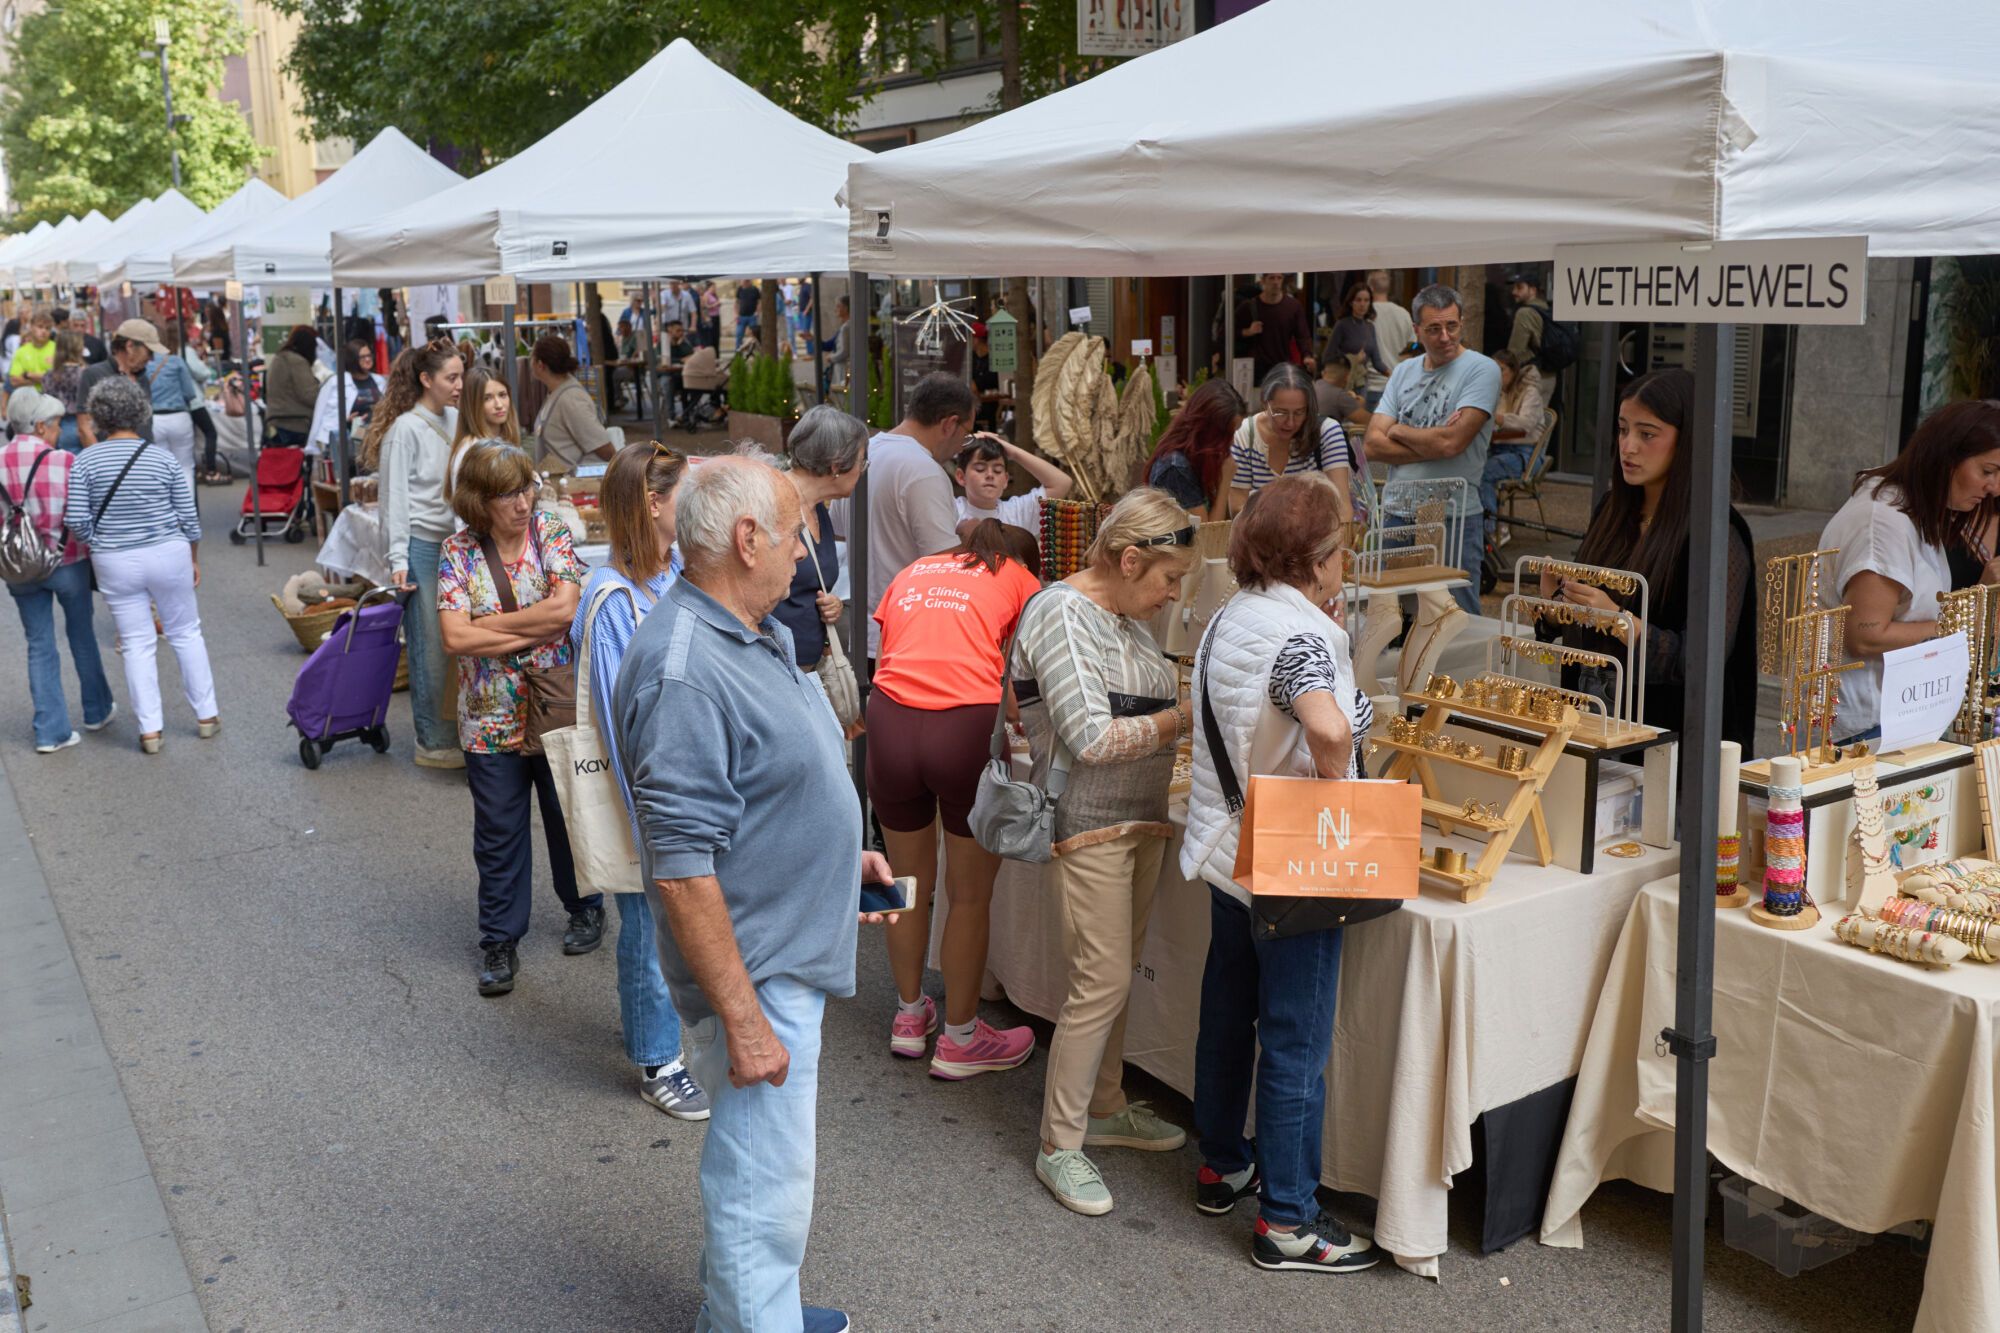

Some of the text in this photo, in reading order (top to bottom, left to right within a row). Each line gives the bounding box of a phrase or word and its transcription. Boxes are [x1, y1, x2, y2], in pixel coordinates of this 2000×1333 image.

[1567, 263, 1849, 309] WETHEM JEWELS
[927, 586, 971, 601] Clínica
[924, 598, 968, 613] Girona
[1901, 675, 1952, 704] OUTLET
[1288, 860, 1379, 878] NIUTA
